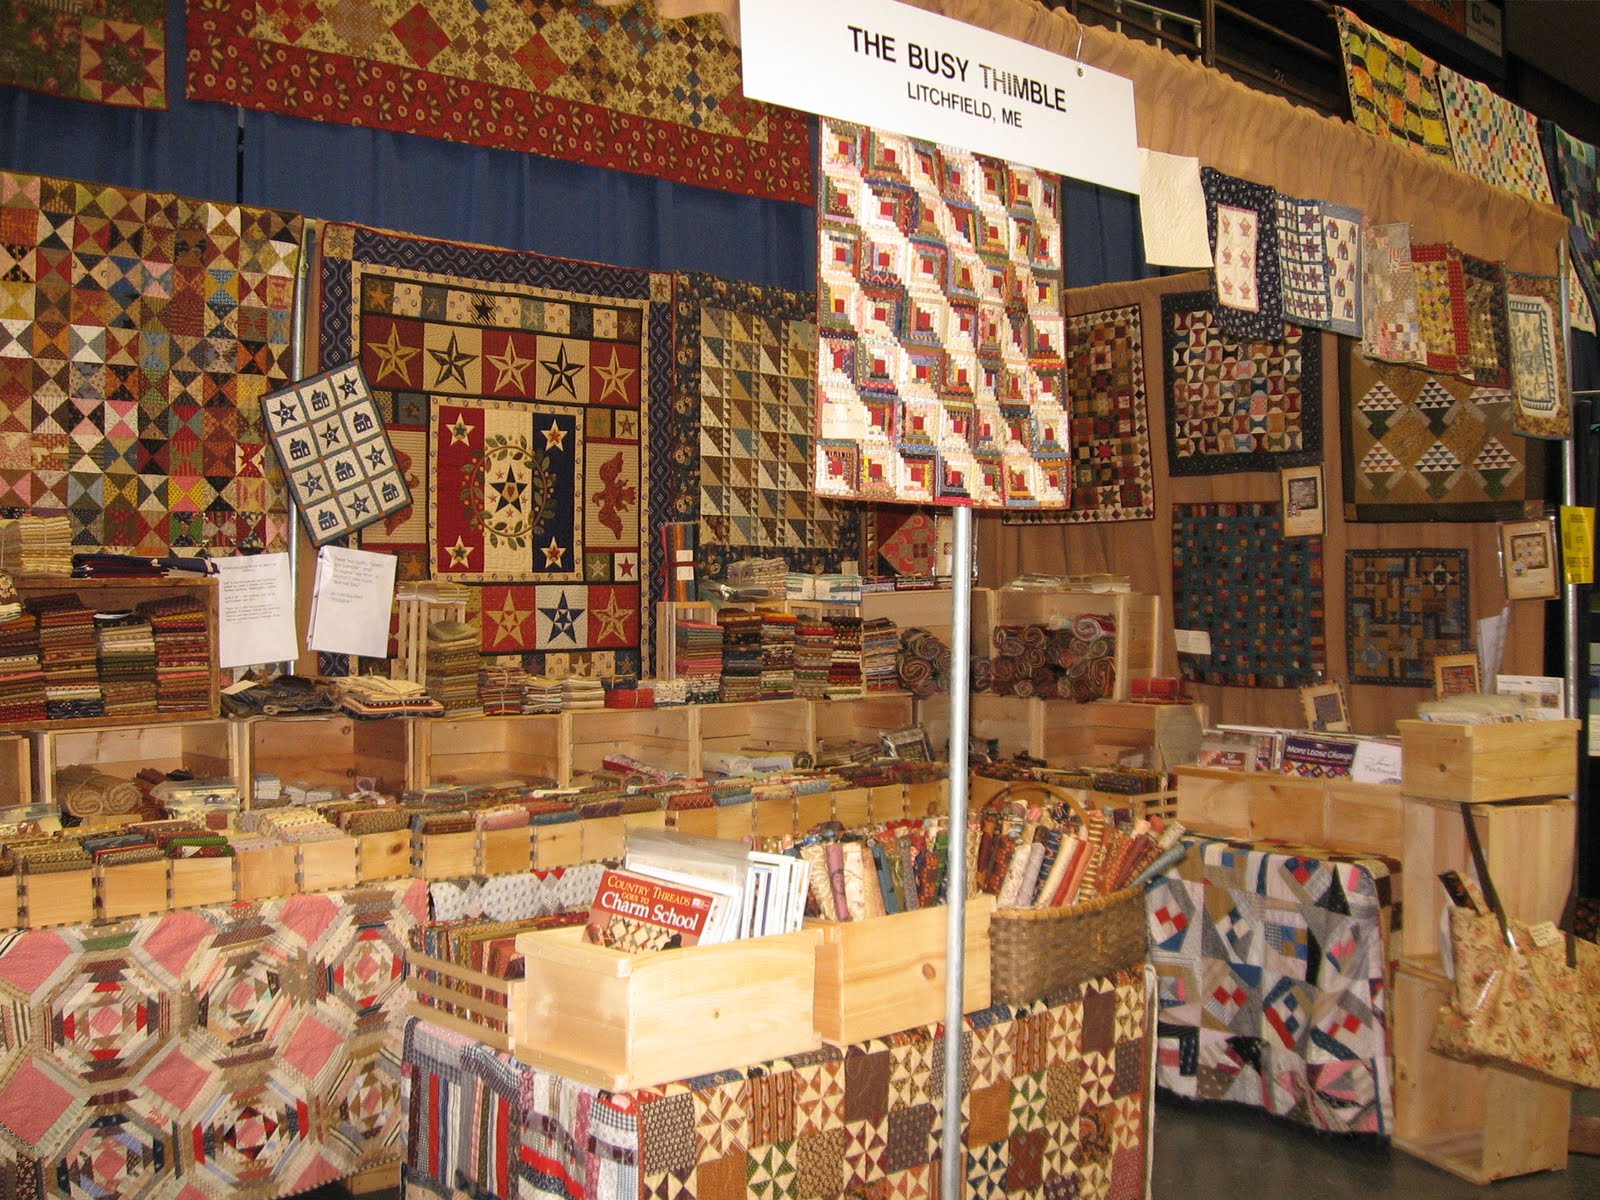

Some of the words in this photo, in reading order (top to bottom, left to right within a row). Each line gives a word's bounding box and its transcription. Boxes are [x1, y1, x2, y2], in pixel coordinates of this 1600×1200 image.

[847, 25, 896, 63] THE
[908, 43, 969, 83] BUSY
[978, 64, 1067, 113] THIMBLE
[907, 82, 996, 123] LITCHFIELD,
[1002, 108, 1023, 128] ME
[1286, 745, 1306, 754] More
[1307, 749, 1327, 757] Loose
[607, 875, 650, 895] COUNTRY
[652, 886, 692, 907] THREADS
[621, 891, 637, 902] GOES
[639, 896, 649, 905] TO
[601, 891, 649, 919] Charm
[652, 905, 699, 931] School
